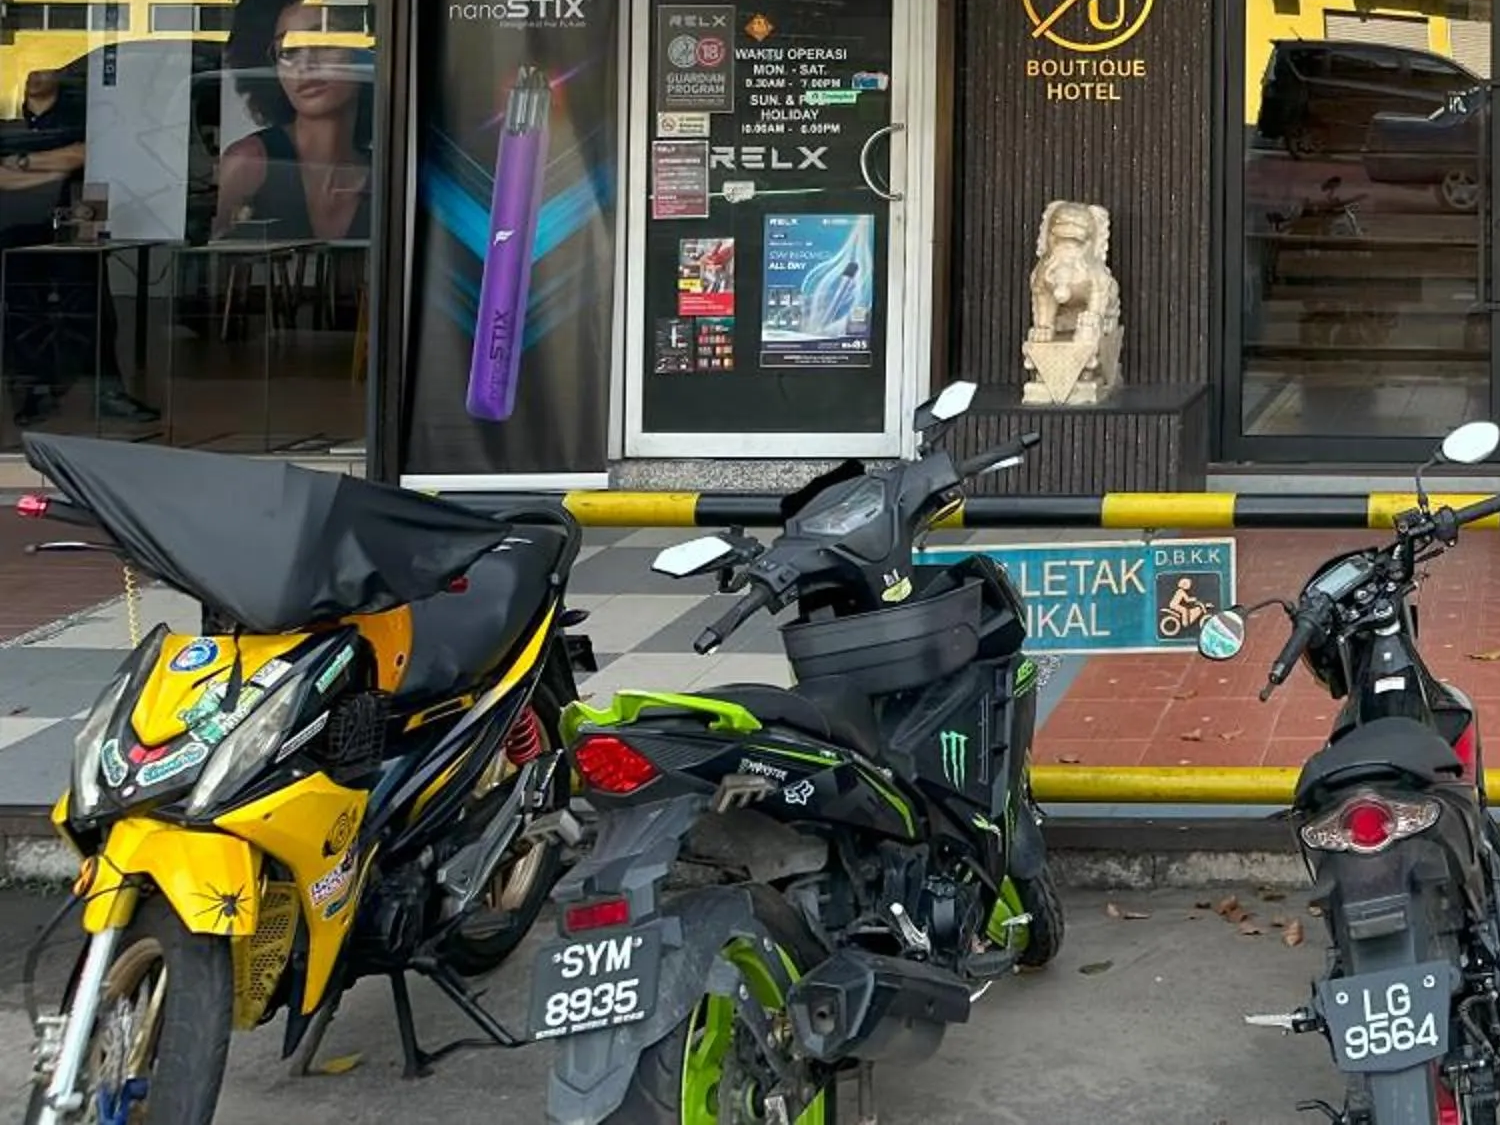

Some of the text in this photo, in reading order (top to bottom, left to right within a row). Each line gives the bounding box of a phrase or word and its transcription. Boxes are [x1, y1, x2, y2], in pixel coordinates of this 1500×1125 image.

[668, 15, 727, 27] RELX
[701, 44, 719, 59] 18
[735, 48, 848, 60] WAKTU OPERASI
[1026, 59, 1147, 76] BOUTIQUE
[666, 73, 726, 85] GUARDIAN
[666, 84, 725, 94] PROGRAM
[1047, 83, 1121, 100] HOTEL
[785, 95, 795, 106] &
[761, 108, 820, 120] HOLIDAY
[710, 146, 829, 170] RELX
[1020, 558, 1147, 597] LETAK
[1025, 602, 1111, 638] IKAL
[561, 935, 633, 978] SYM
[544, 978, 639, 1026] 8935
[1362, 982, 1412, 1023] LG
[1343, 1012, 1440, 1060] 9564
